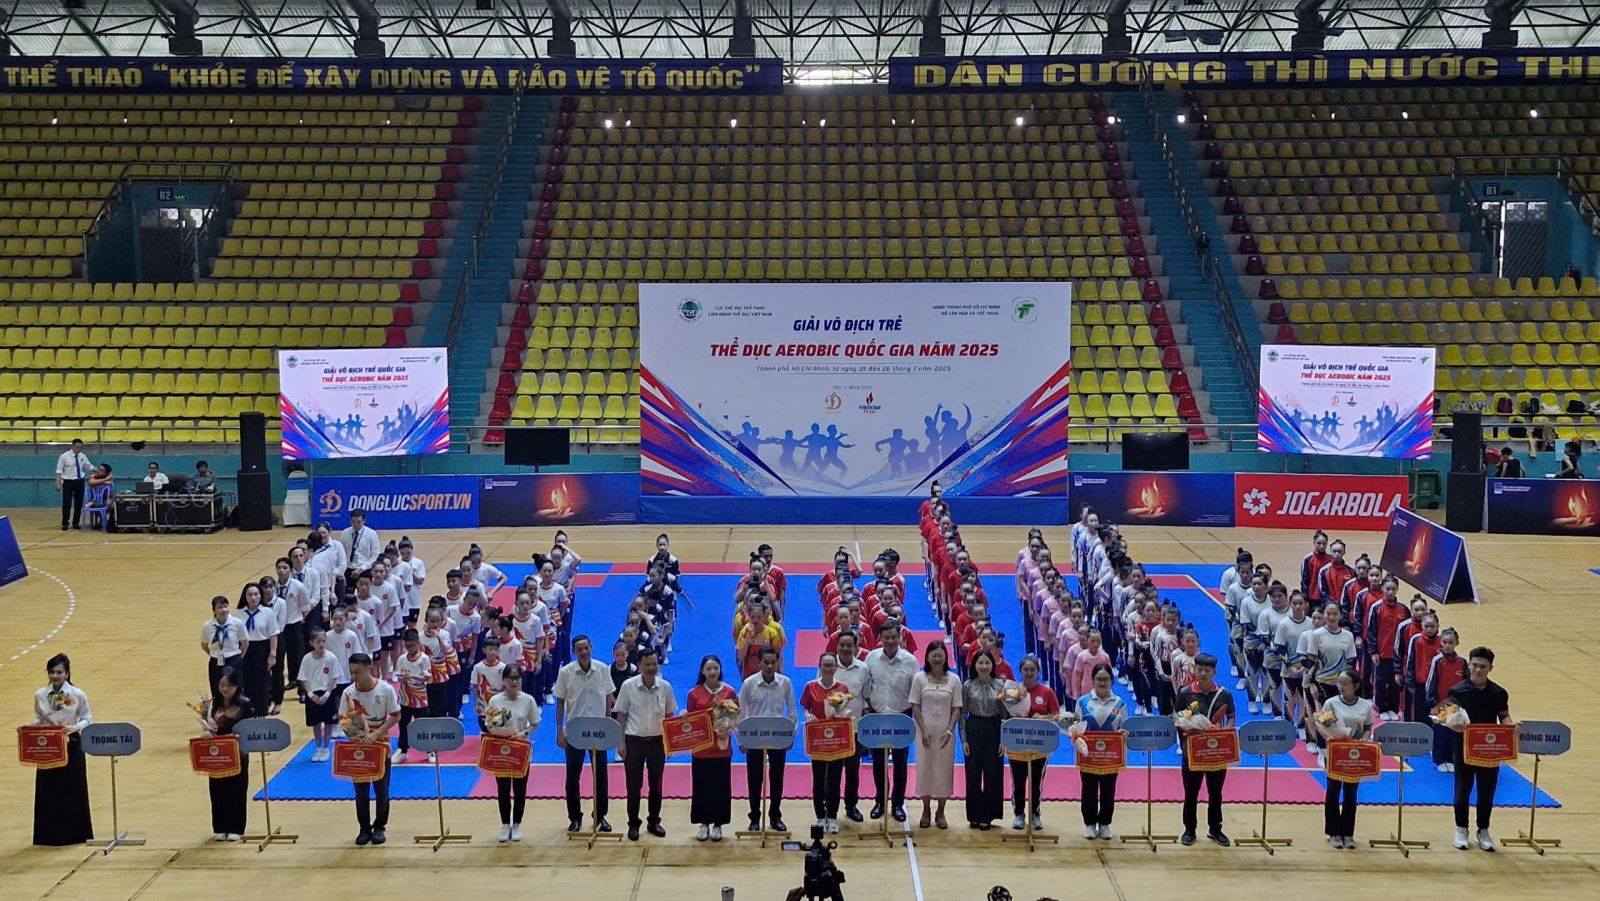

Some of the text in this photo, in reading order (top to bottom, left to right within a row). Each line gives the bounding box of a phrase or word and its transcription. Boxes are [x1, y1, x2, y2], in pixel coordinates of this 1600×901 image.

[4, 60, 59, 87] THỂ
[67, 67, 142, 87] THAO
[256, 61, 296, 88] ĐỂ
[304, 65, 361, 88] XÂY
[371, 66, 451, 92] DỰNG
[461, 64, 500, 89] VÀ
[508, 63, 566, 89] BẢO
[576, 66, 610, 92] VỆ
[621, 62, 657, 89] TỔ
[914, 60, 1022, 87] DÂN
[1043, 58, 1226, 87] CƯỜNG
[1246, 54, 1328, 82] THÌ
[1349, 53, 1498, 80] NƯỚC
[160, 190, 171, 200] B2
[1486, 186, 1497, 195] B1
[793, 314, 903, 335] GIẢI VÔ ĐỊCH TRẺ
[711, 337, 999, 361] THỂ DỤC AEROBIC QUỐC GIA NĂM 2025
[348, 493, 472, 512] DONGLUCSPORT.VN
[1276, 492, 1402, 517] JOGARBOLA
[91, 734, 133, 745] TRỌNG TÀI
[417, 731, 456, 740] HẢI PHÒNG
[581, 729, 606, 741] HÀ NỘI
[1545, 734, 1561, 743] NAI
